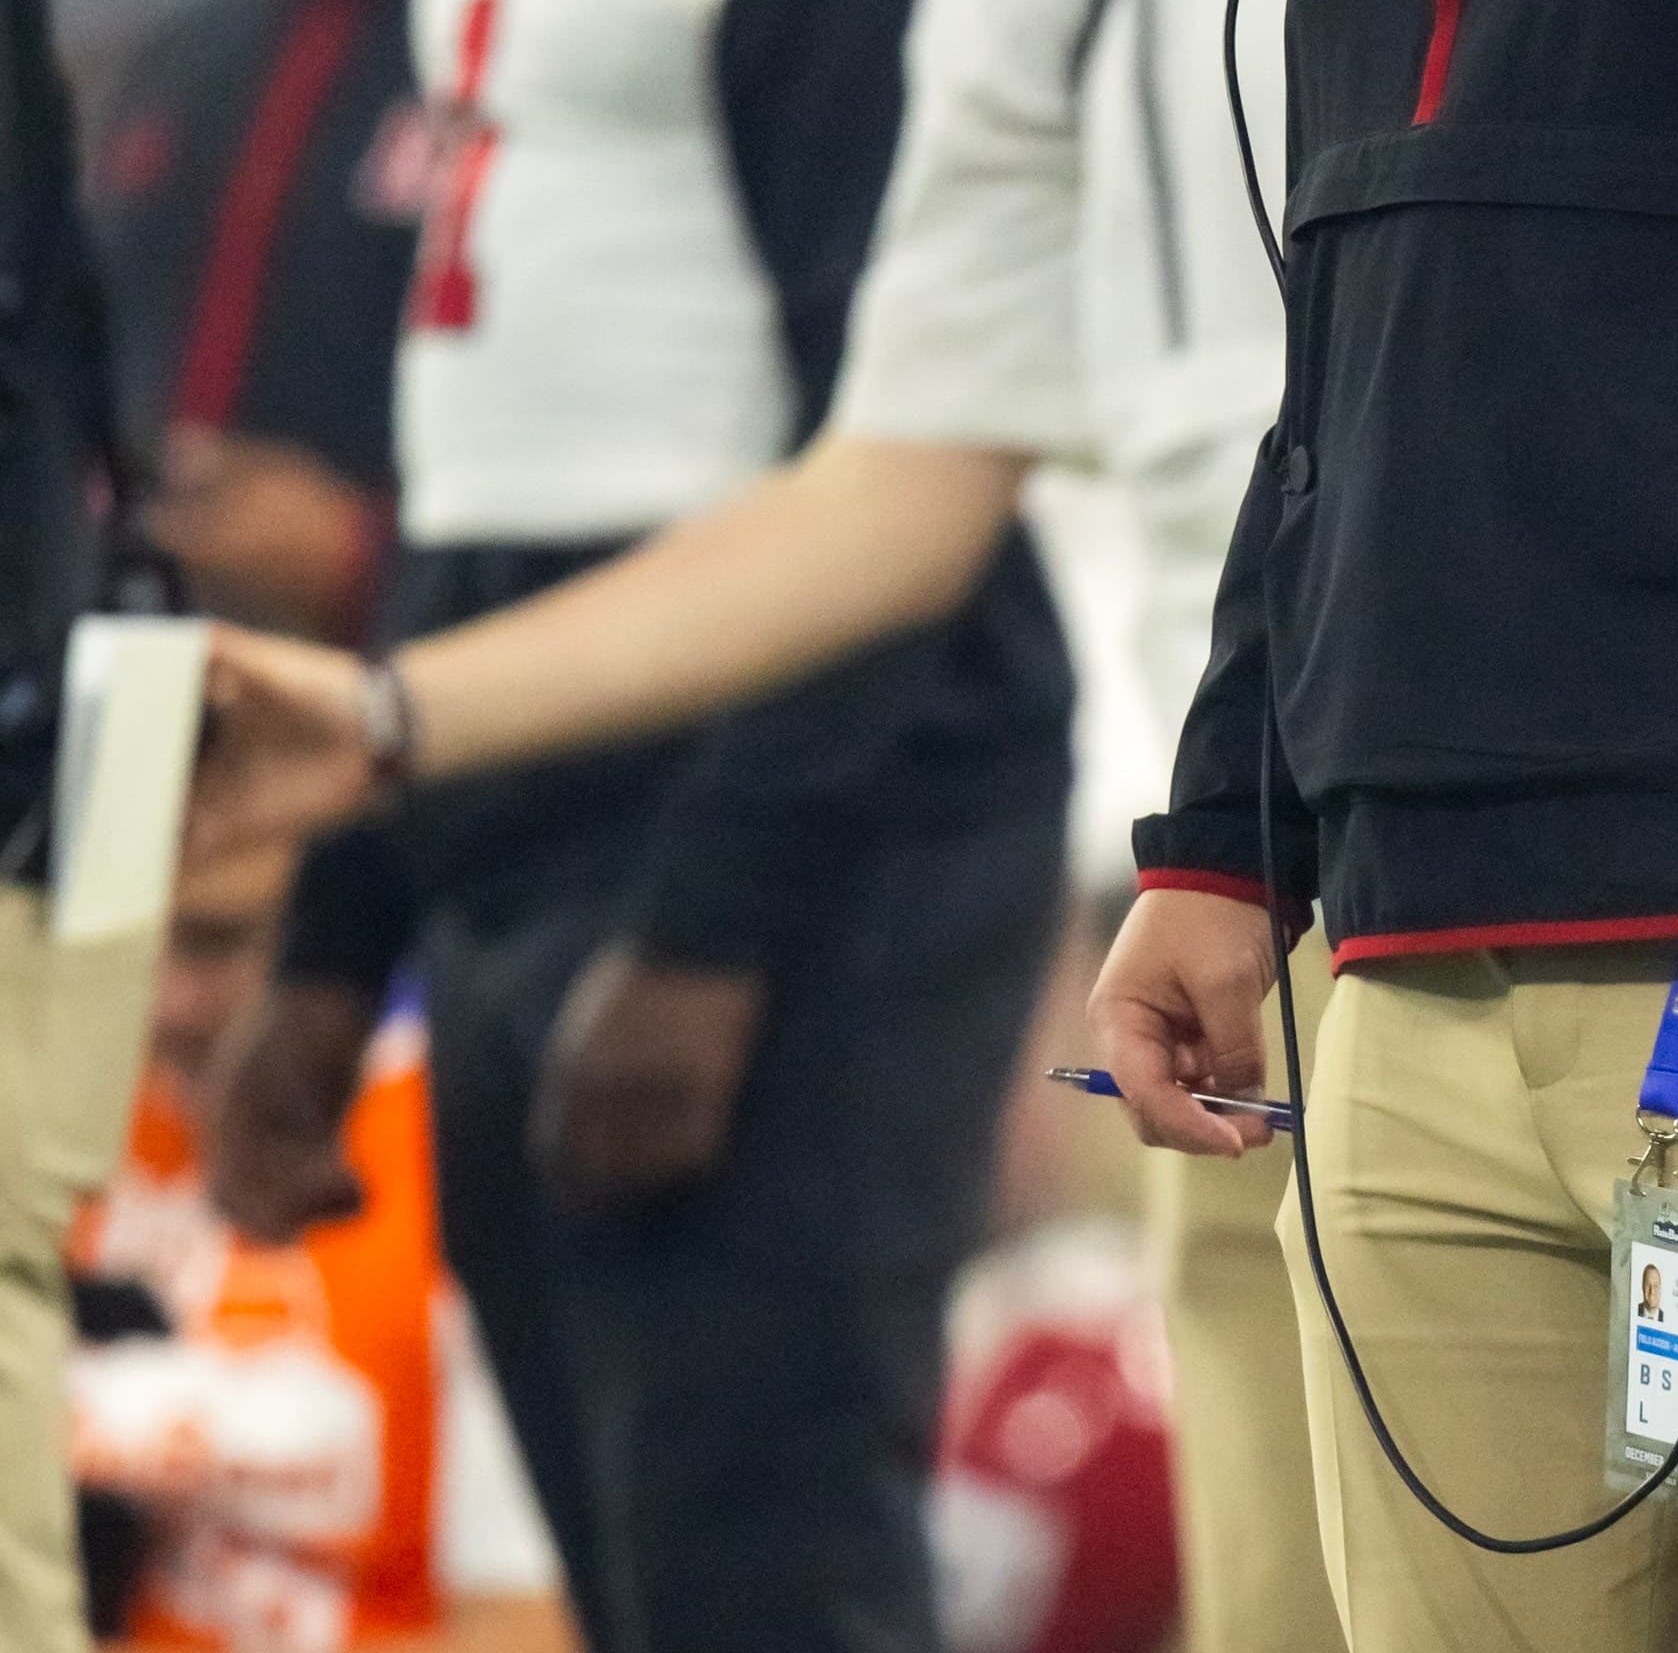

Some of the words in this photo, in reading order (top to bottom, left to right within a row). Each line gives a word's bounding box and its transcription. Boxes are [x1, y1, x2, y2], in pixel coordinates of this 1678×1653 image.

[1640, 1364, 1650, 1385] B
[1661, 1369, 1672, 1391] S
[1639, 1401, 1648, 1424] L
[1625, 1446, 1665, 1467] DECEMBER
